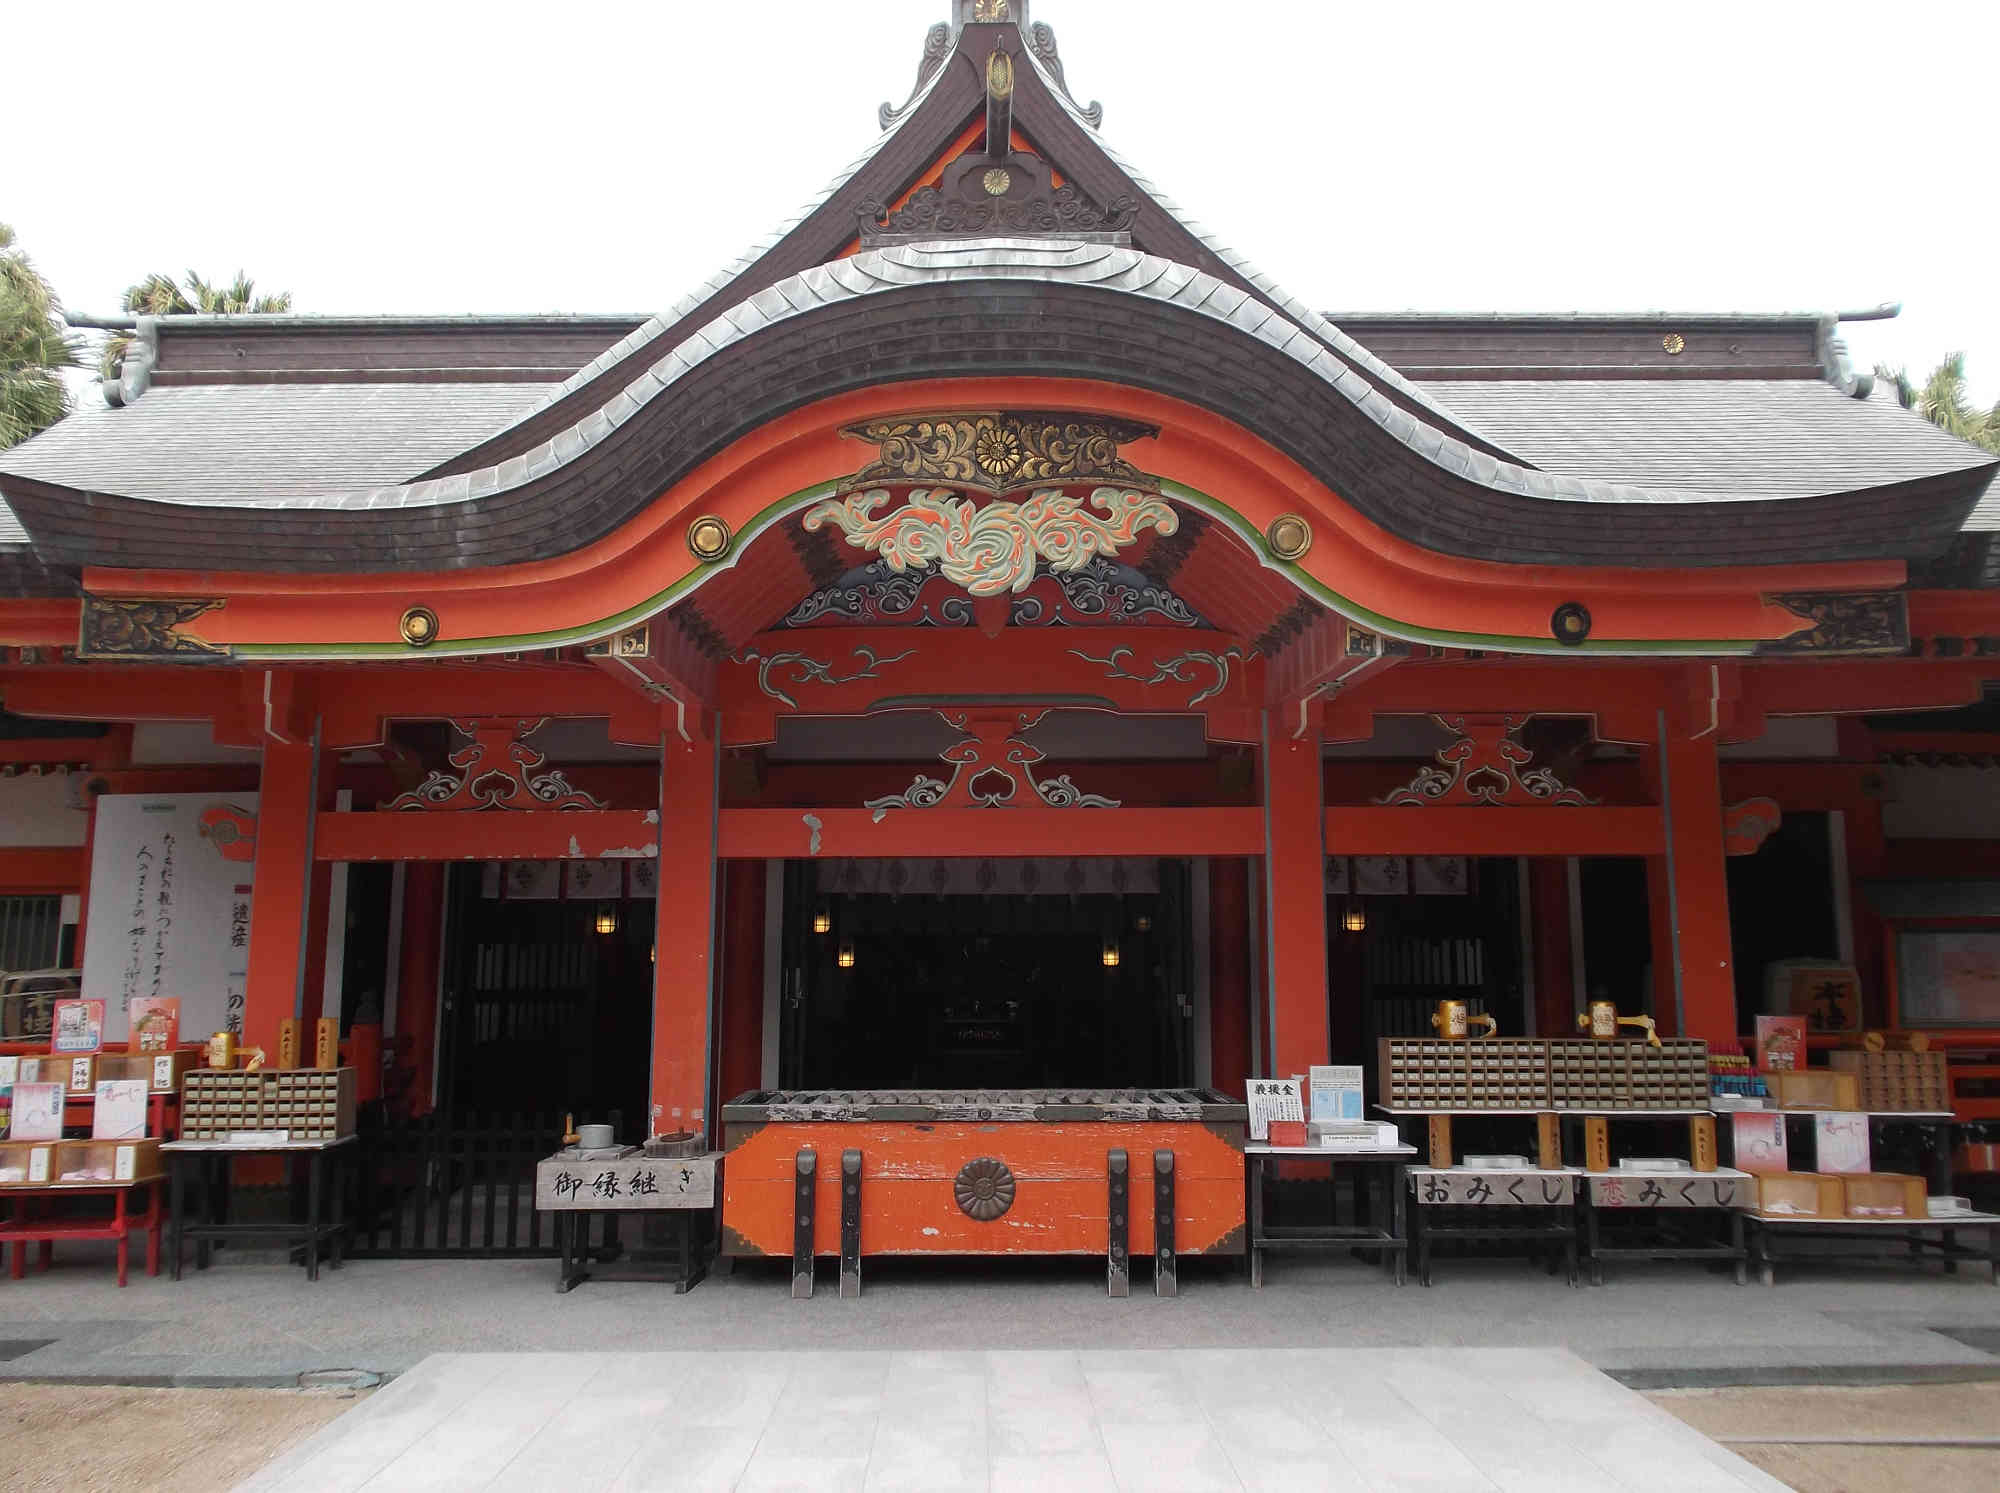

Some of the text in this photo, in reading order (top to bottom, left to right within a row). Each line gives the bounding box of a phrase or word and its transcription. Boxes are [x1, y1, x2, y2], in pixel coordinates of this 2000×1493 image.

[1255, 1083, 1294, 1096] 義援金
[552, 1167, 695, 1201] 御縁継ぎ
[1424, 1175, 1564, 1204] おみくじ
[1600, 1178, 1736, 1207] 恋みくじ
